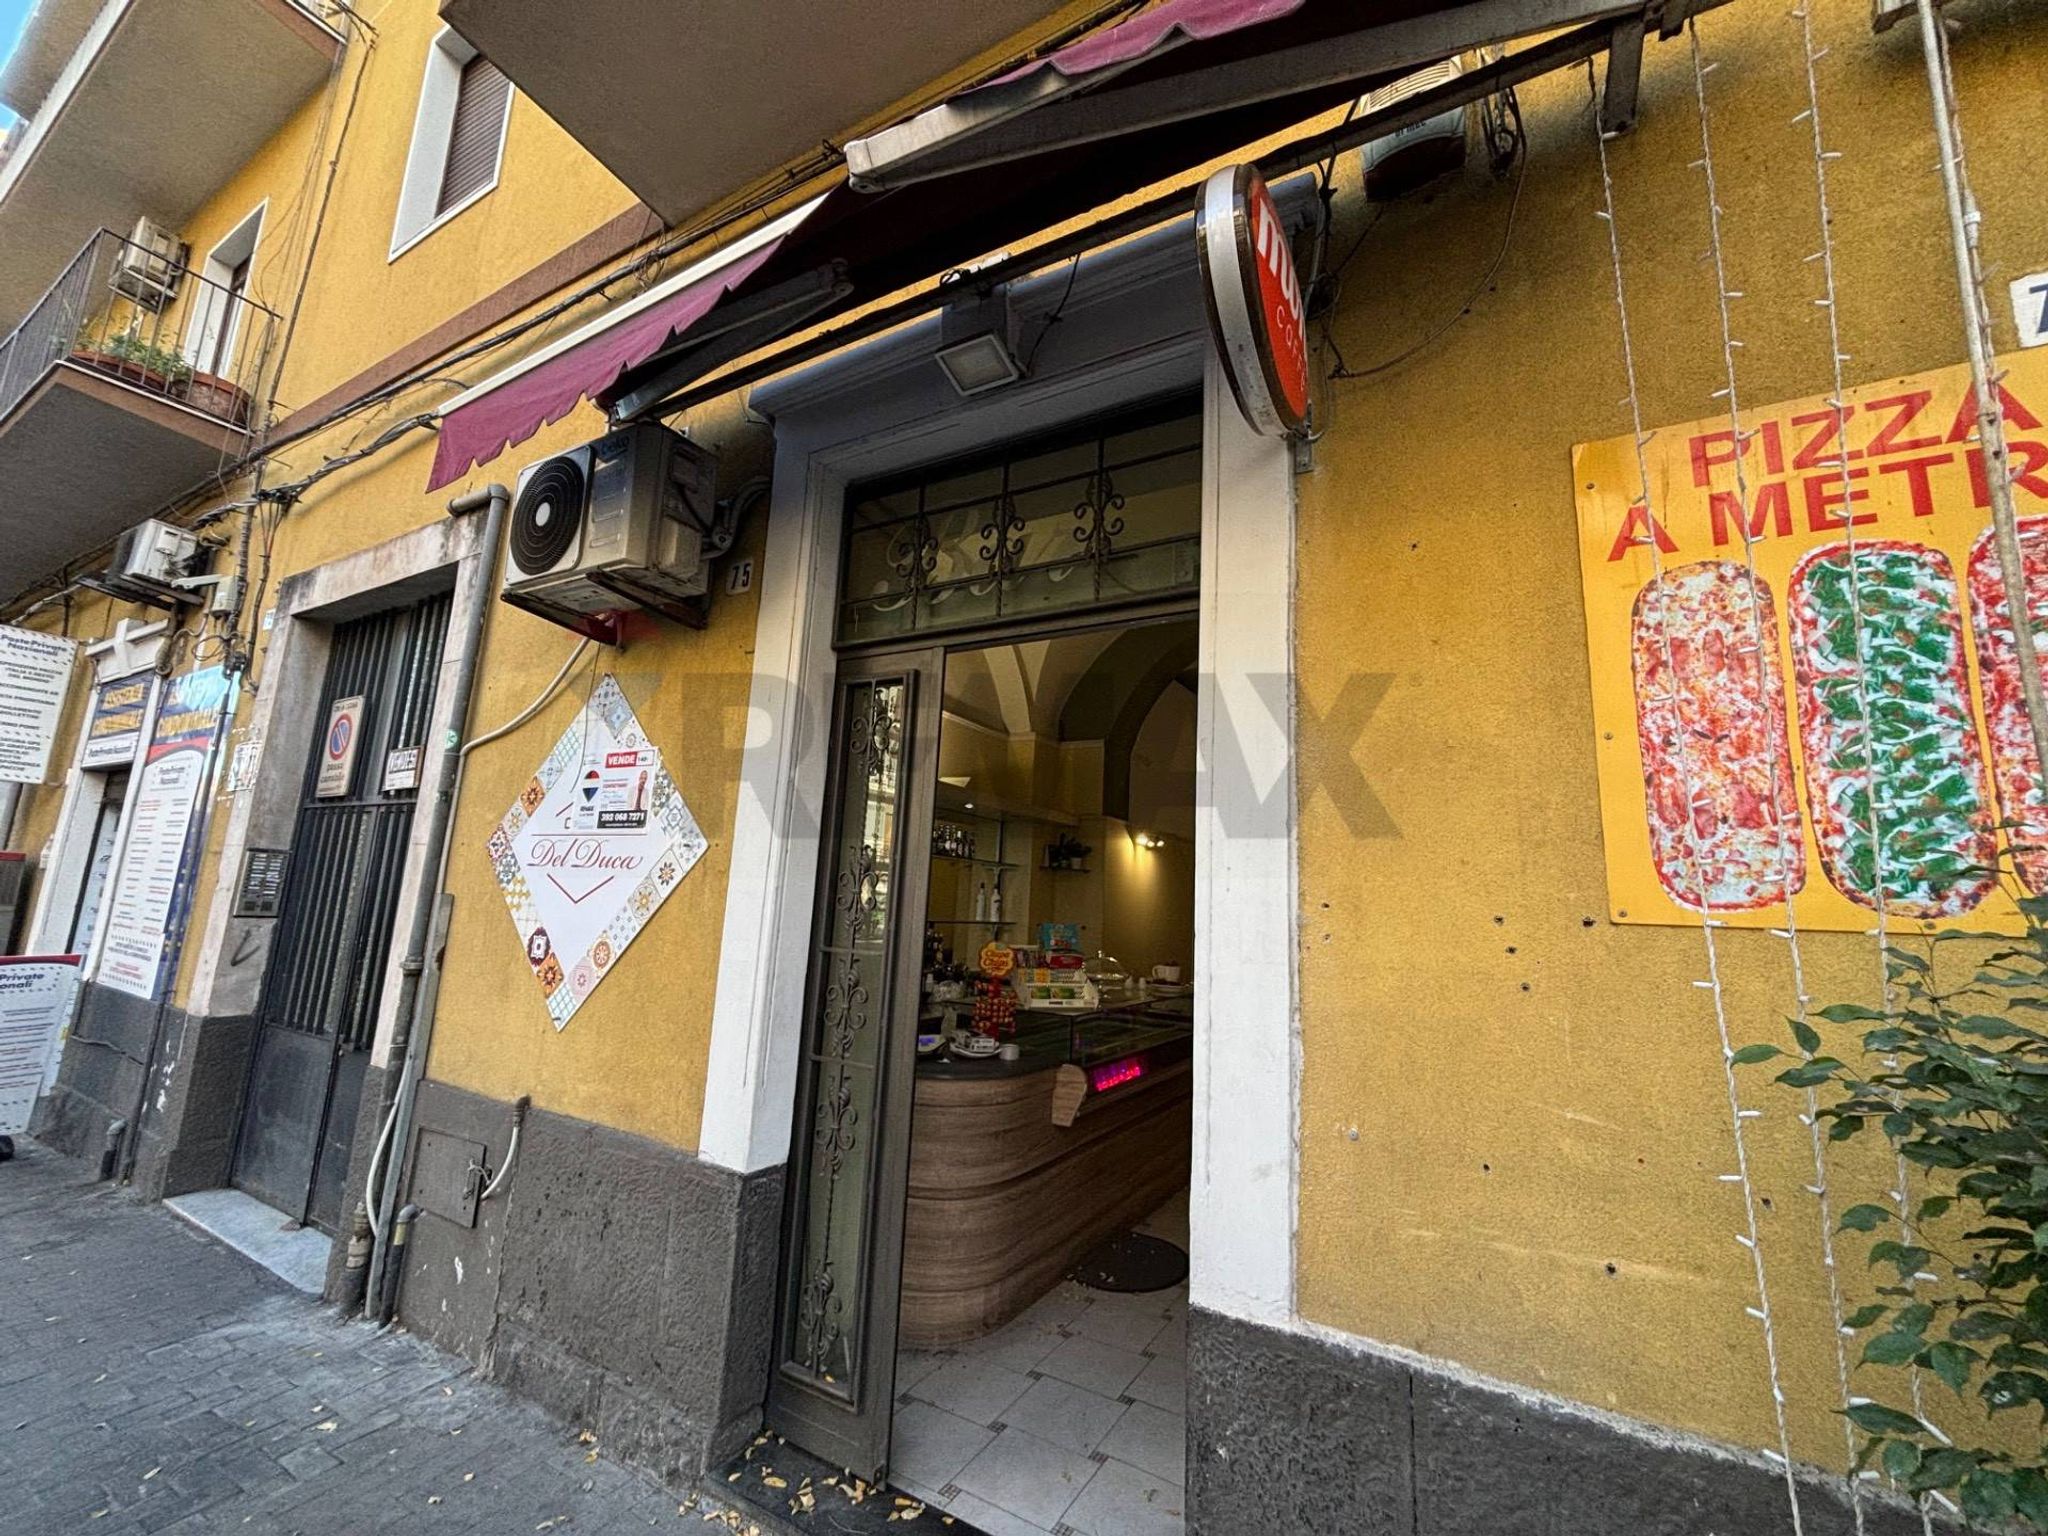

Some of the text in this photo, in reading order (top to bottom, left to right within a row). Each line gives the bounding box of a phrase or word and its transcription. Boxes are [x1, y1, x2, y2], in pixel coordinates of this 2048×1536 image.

[1689, 378, 2044, 488] PIZZA
[1607, 505, 1679, 562] A
[608, 754, 636, 766] VENDE
[527, 837, 643, 869] Del Duca
